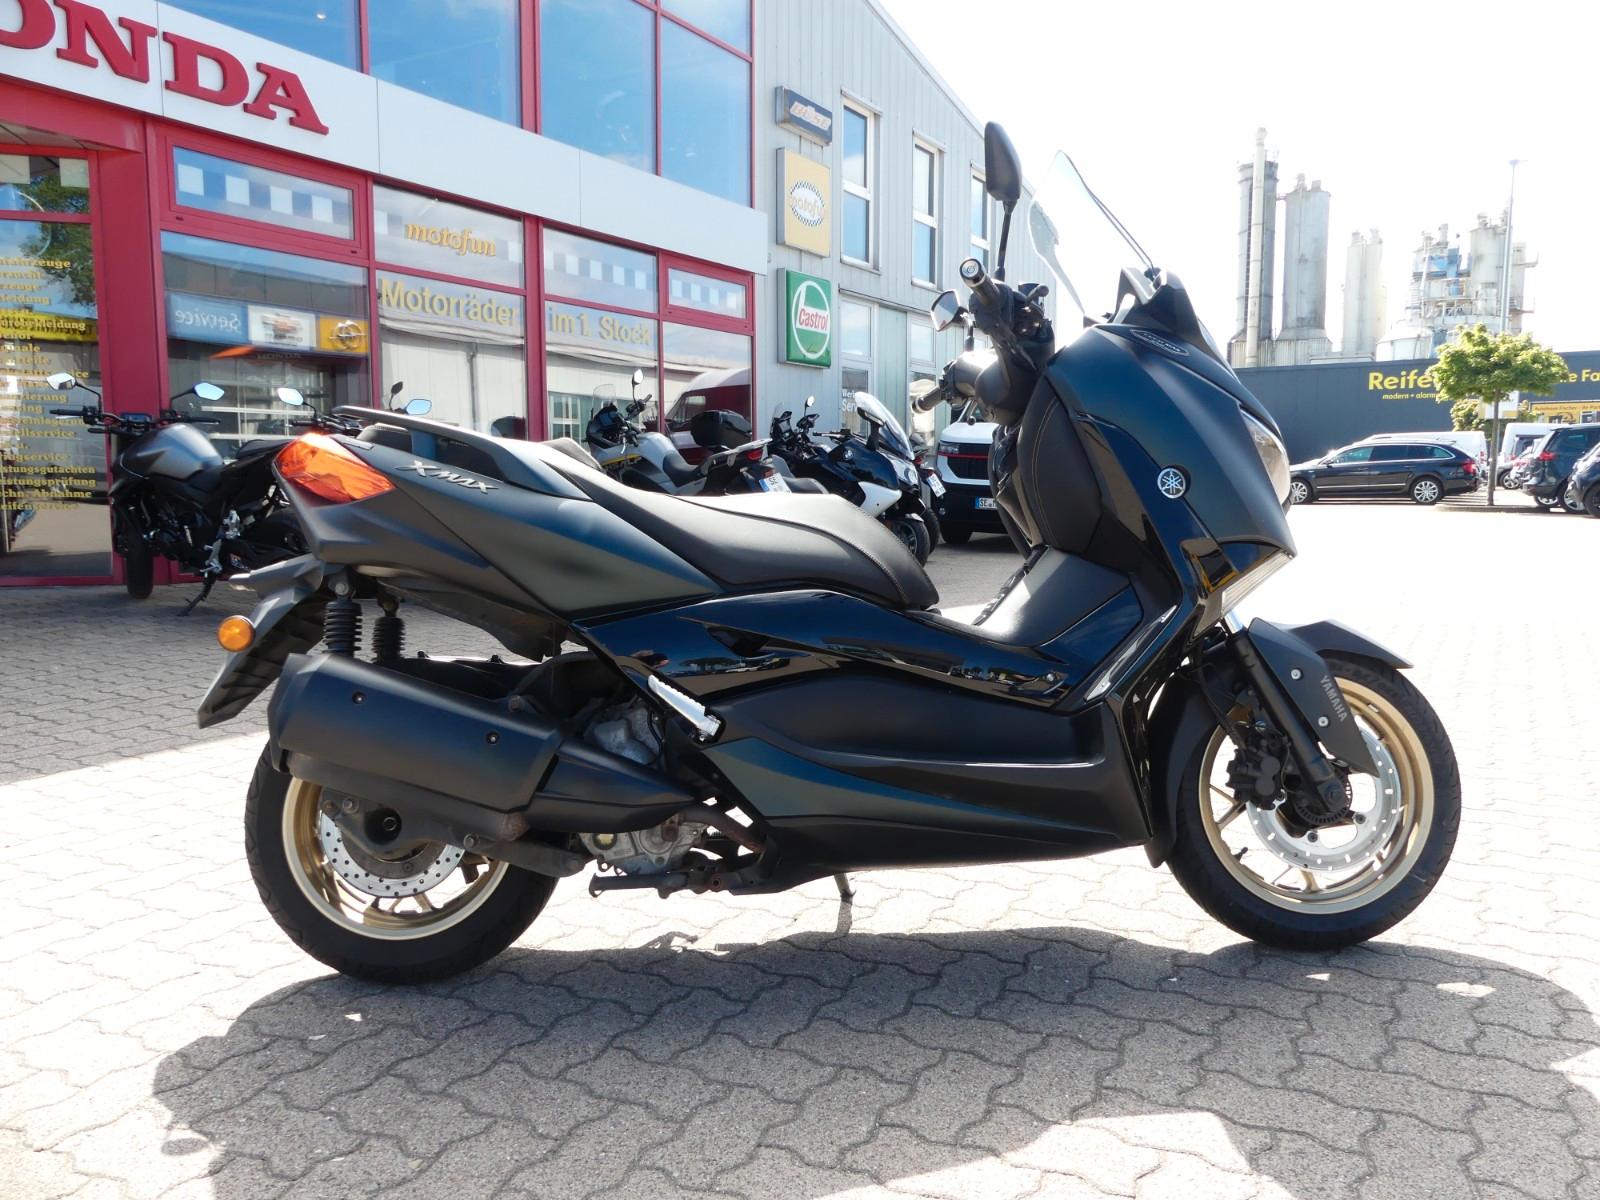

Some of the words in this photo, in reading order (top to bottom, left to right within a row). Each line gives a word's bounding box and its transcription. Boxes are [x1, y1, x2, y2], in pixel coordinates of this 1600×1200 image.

[404, 223, 496, 256] motofun
[381, 278, 519, 326] Motorräder
[548, 305, 575, 336] im
[599, 315, 652, 345] Stock
[799, 308, 829, 330] Castrol
[1368, 369, 1436, 391] Reife
[1382, 392, 1409, 400] modern
[1318, 674, 1348, 723] YAMAHA
